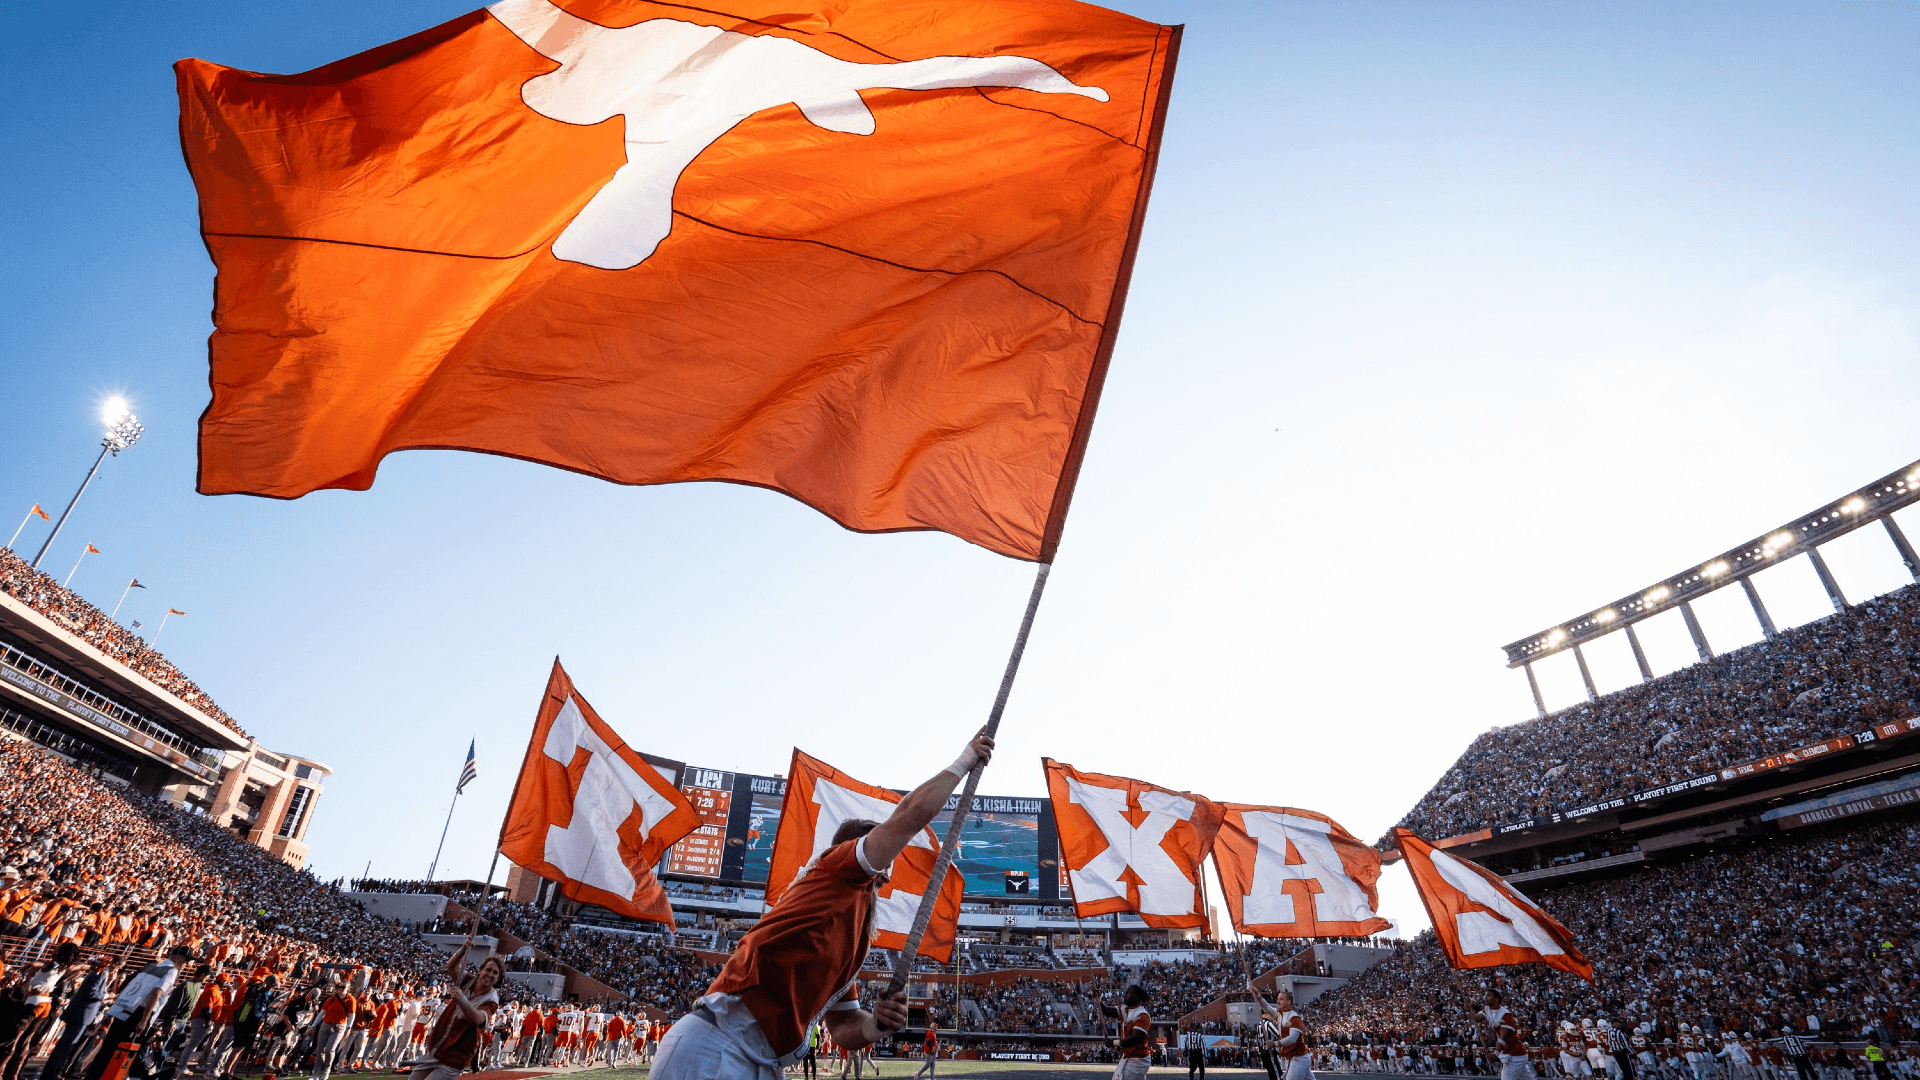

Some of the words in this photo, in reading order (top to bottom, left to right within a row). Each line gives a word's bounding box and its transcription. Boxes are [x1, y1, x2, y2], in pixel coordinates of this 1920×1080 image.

[0, 667, 34, 689] WELCOME
[36, 683, 46, 695] TO
[43, 689, 60, 702] THE
[66, 700, 93, 718] PLAYOFF
[92, 713, 111, 728] FIRST
[109, 720, 130, 736] ROUND
[1855, 730, 1875, 744] 7:26
[1737, 764, 1754, 774] TEXAS
[1766, 758, 1775, 768] 21
[1802, 744, 1829, 758] CLEMSON
[1836, 740, 1843, 749] 7
[750, 778, 777, 794] KURT
[779, 782, 787, 794] &
[696, 796, 714, 808] 7:26
[720, 800, 724, 808] 7
[1564, 804, 1598, 818] WELCOME
[1598, 802, 1609, 812] TO
[1609, 798, 1624, 808] THE
[1634, 788, 1666, 802] PLAYOFF
[1666, 783, 1690, 796] FIRST
[1690, 774, 1718, 788] ROUND
[972, 798, 982, 811] &
[984, 798, 1012, 812] KISHA
[1016, 800, 1042, 813] ITKIN
[1800, 808, 1836, 824] DARRELL
[1838, 806, 1846, 816] K
[1846, 800, 1875, 814] ROYAL
[1882, 791, 1914, 806] TEXAS
[700, 826, 718, 836] STATS
[1066, 776, 1196, 916] X
[1241, 811, 1378, 924] A
[562, 1016, 573, 1026] 10
[1788, 1038, 1796, 1046] R
